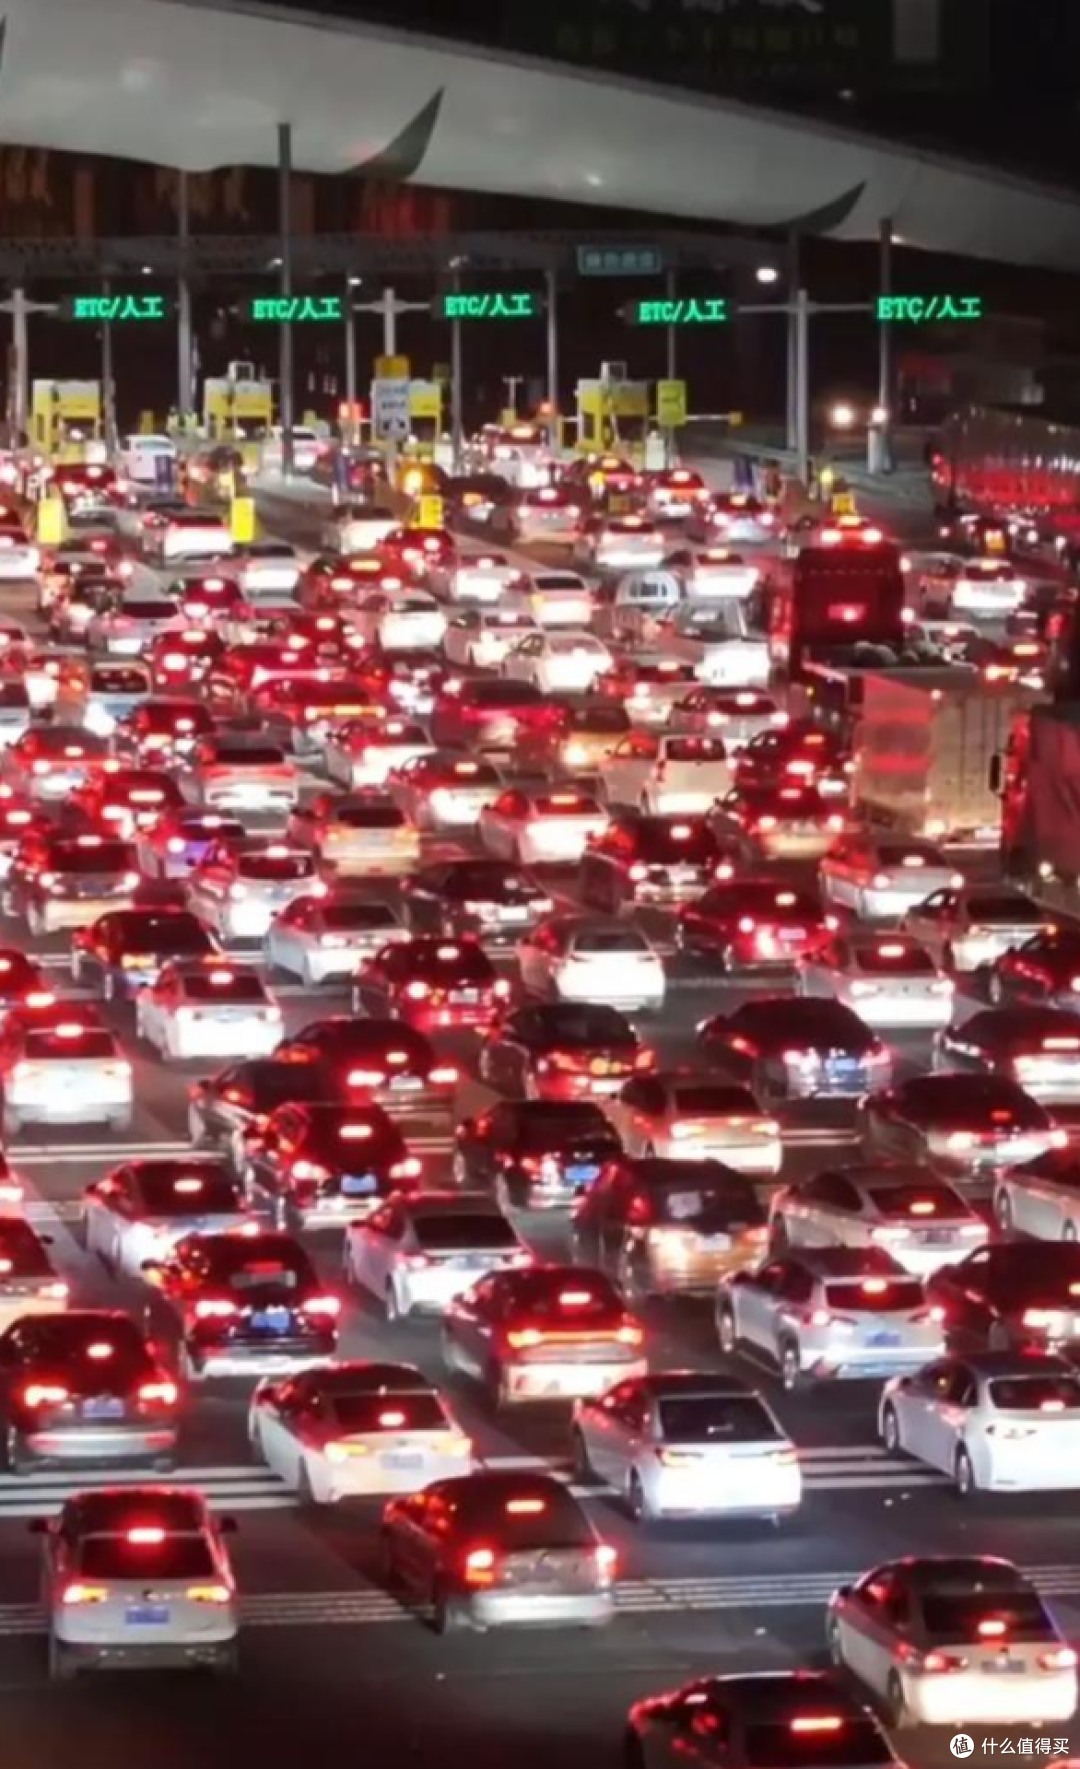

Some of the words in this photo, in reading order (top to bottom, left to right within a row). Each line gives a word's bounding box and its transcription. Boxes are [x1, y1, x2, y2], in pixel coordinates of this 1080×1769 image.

[74, 297, 163, 319] ETC/人工
[253, 297, 341, 319] ETC/人工
[444, 295, 532, 317] ETC/人工
[639, 300, 727, 322] ETC/人工
[877, 296, 981, 320] ETC/人工
